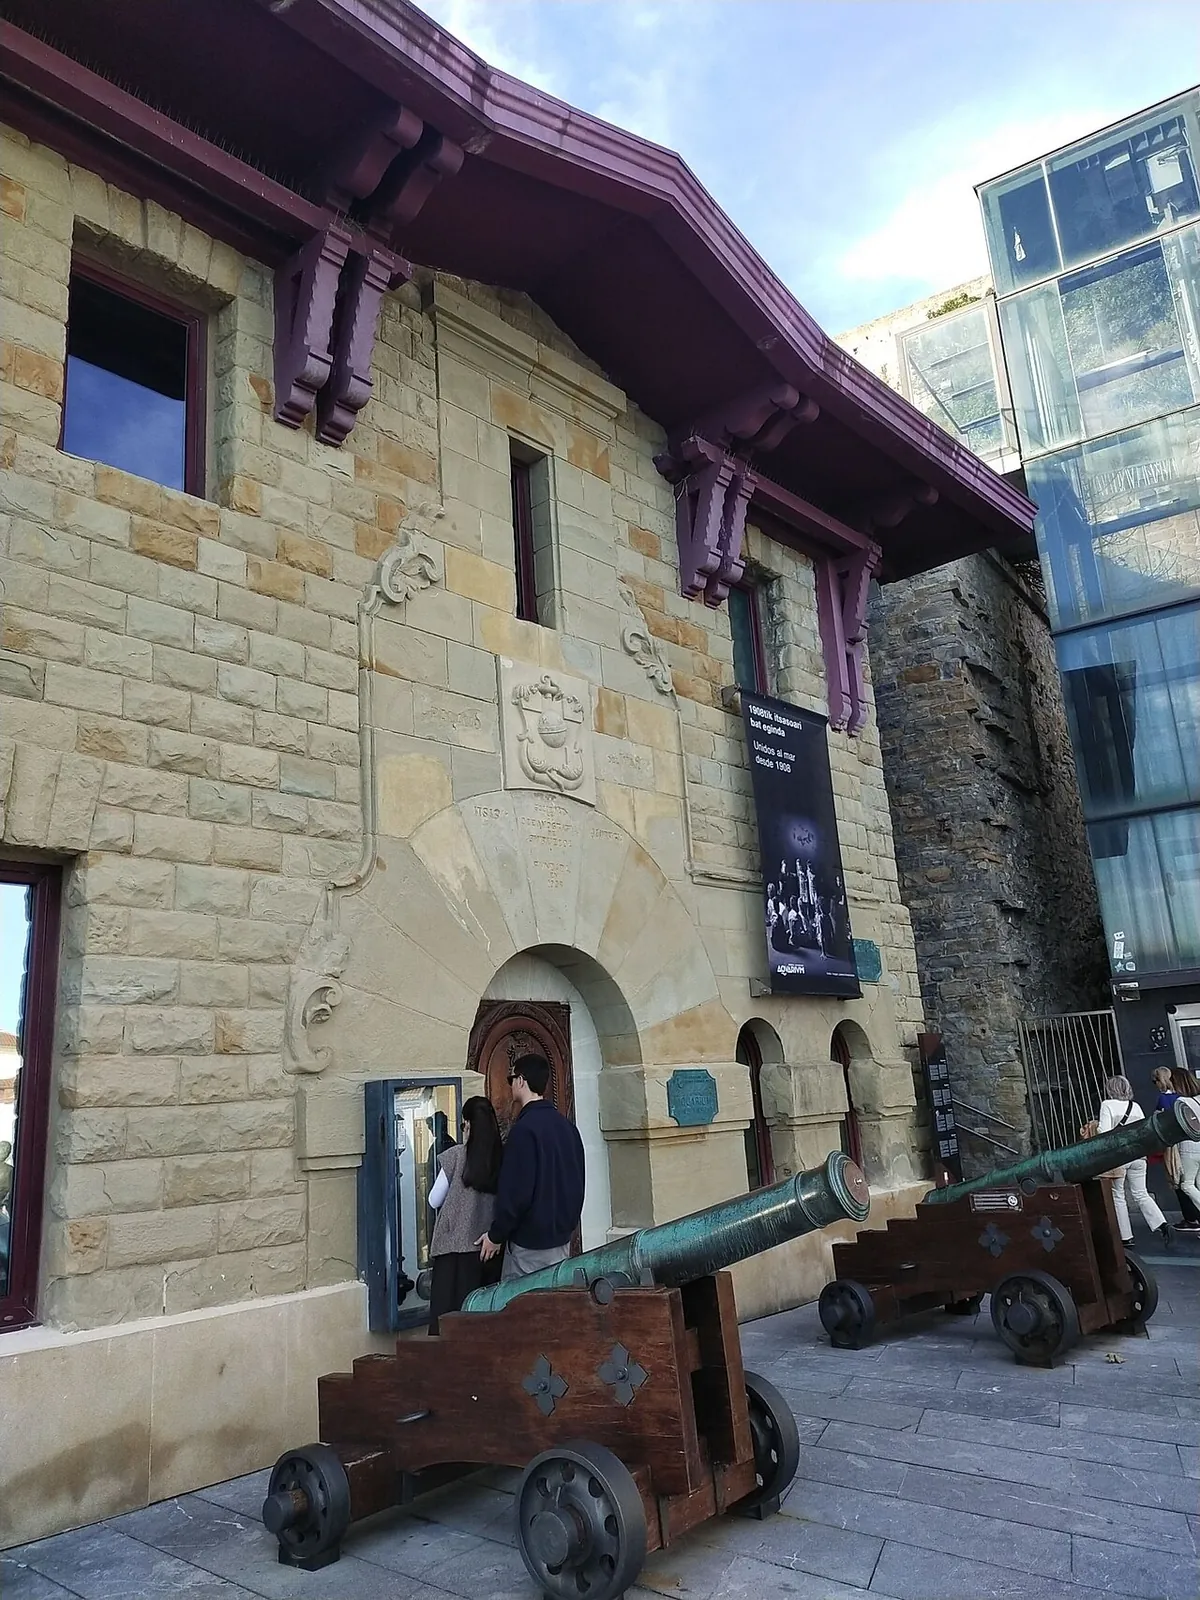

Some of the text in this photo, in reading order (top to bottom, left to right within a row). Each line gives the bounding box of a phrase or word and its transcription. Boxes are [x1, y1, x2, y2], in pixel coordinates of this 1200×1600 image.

[748, 704, 802, 730] 1908tik itsasoari
[750, 717, 786, 737] bat eginda
[753, 740, 796, 762] Unidos al mar
[755, 754, 792, 773] desde 1908
